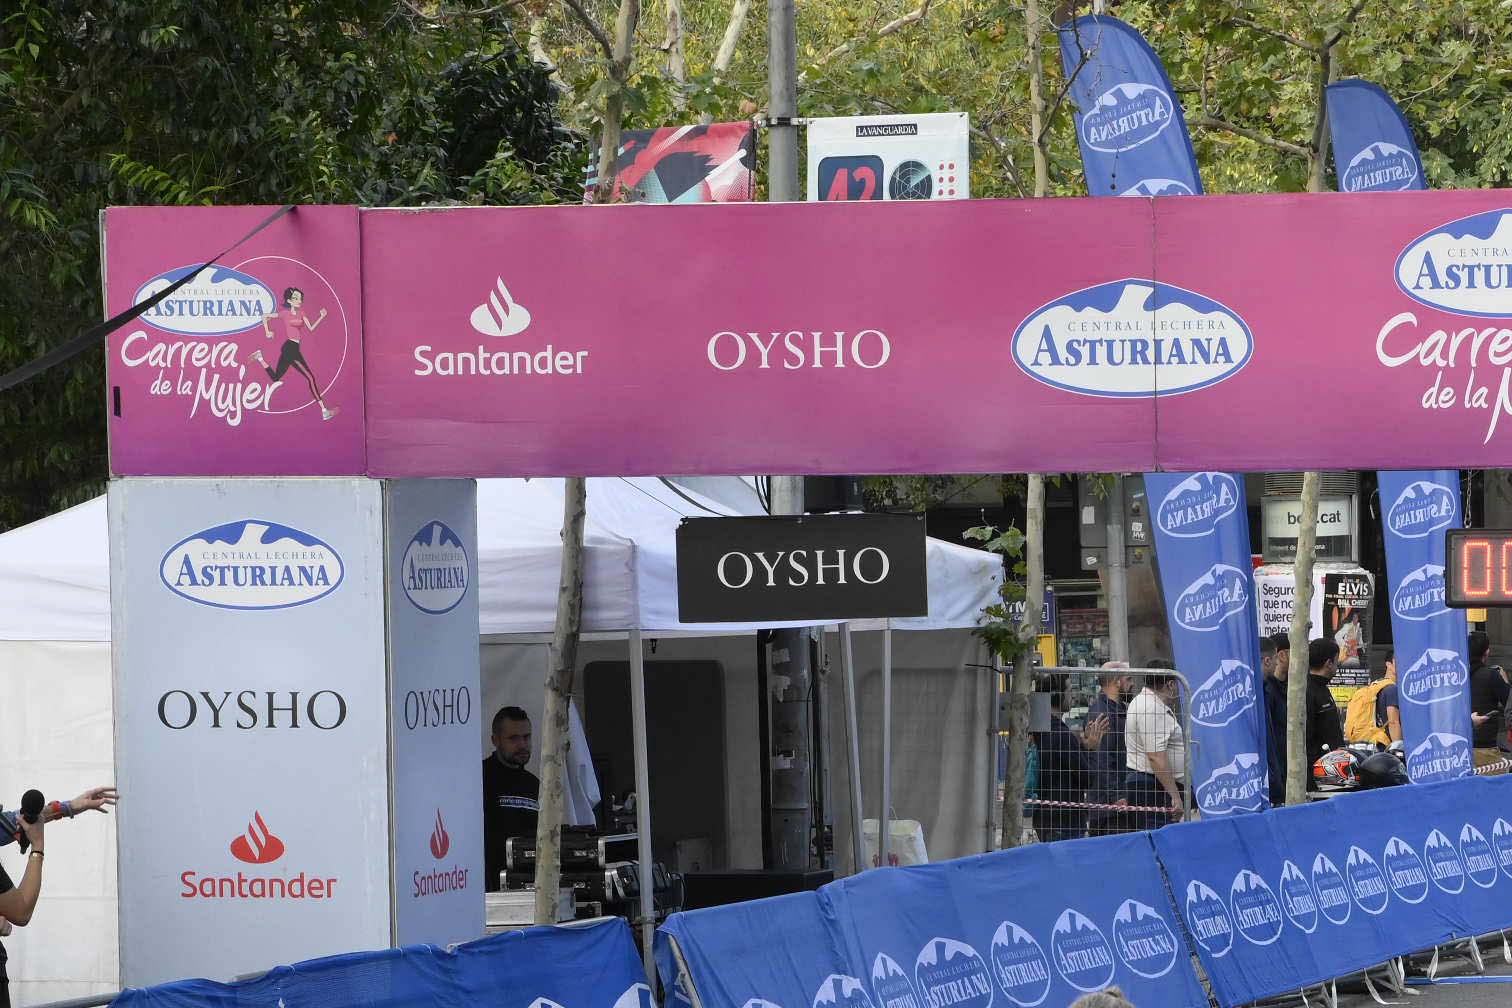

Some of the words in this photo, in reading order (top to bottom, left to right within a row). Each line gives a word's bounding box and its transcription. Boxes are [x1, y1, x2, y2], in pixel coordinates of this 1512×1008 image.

[172, 287, 208, 296] ENTRAL
[1067, 320, 1143, 332] CENTRAL
[1150, 318, 1226, 331] LECHERA
[121, 331, 239, 368] Carrera
[414, 345, 589, 376] Santander
[707, 329, 891, 371] OYSHO
[1030, 323, 1235, 367] ASTURIANA
[150, 370, 173, 395] de
[177, 370, 192, 396] la
[190, 365, 283, 427] Mujer
[1421, 369, 1457, 410] de
[1464, 368, 1489, 410] la
[174, 553, 331, 588] ASTURIANA
[202, 551, 260, 560] CENTRAL
[266, 551, 325, 560] LECHERA
[717, 547, 891, 590] OYSHO
[407, 558, 465, 592] ASTURIANA
[1337, 582, 1369, 596] ELVIS
[157, 689, 347, 730] OYSHO
[404, 686, 471, 730] OYSHO
[180, 871, 337, 900] Santander
[413, 864, 469, 899] Santander
[995, 956, 1048, 989] ASTURIANA
[1058, 943, 1112, 975] ASTURIANA
